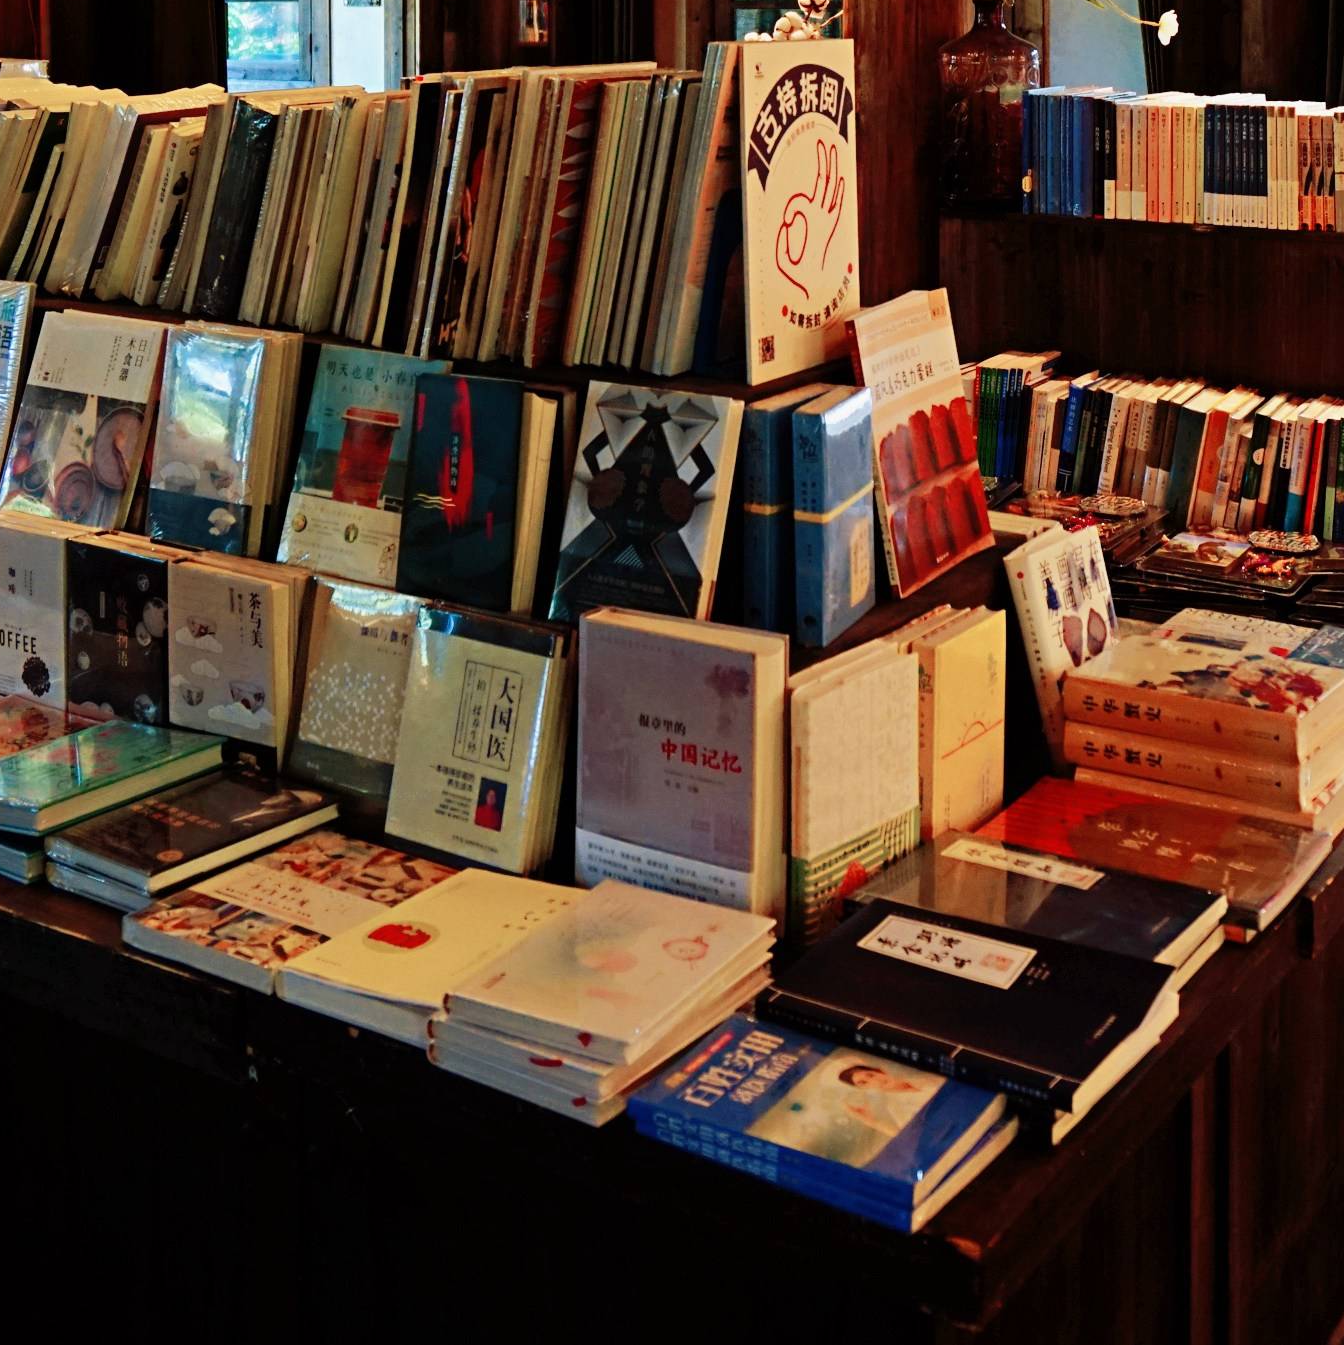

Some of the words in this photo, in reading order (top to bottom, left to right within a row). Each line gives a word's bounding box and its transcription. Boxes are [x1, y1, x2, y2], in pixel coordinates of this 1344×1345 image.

[755, 71, 839, 155] 支持拆阅
[248, 592, 263, 649] 茶与美
[486, 676, 517, 762] 大国医
[660, 737, 742, 774] 中国记忆
